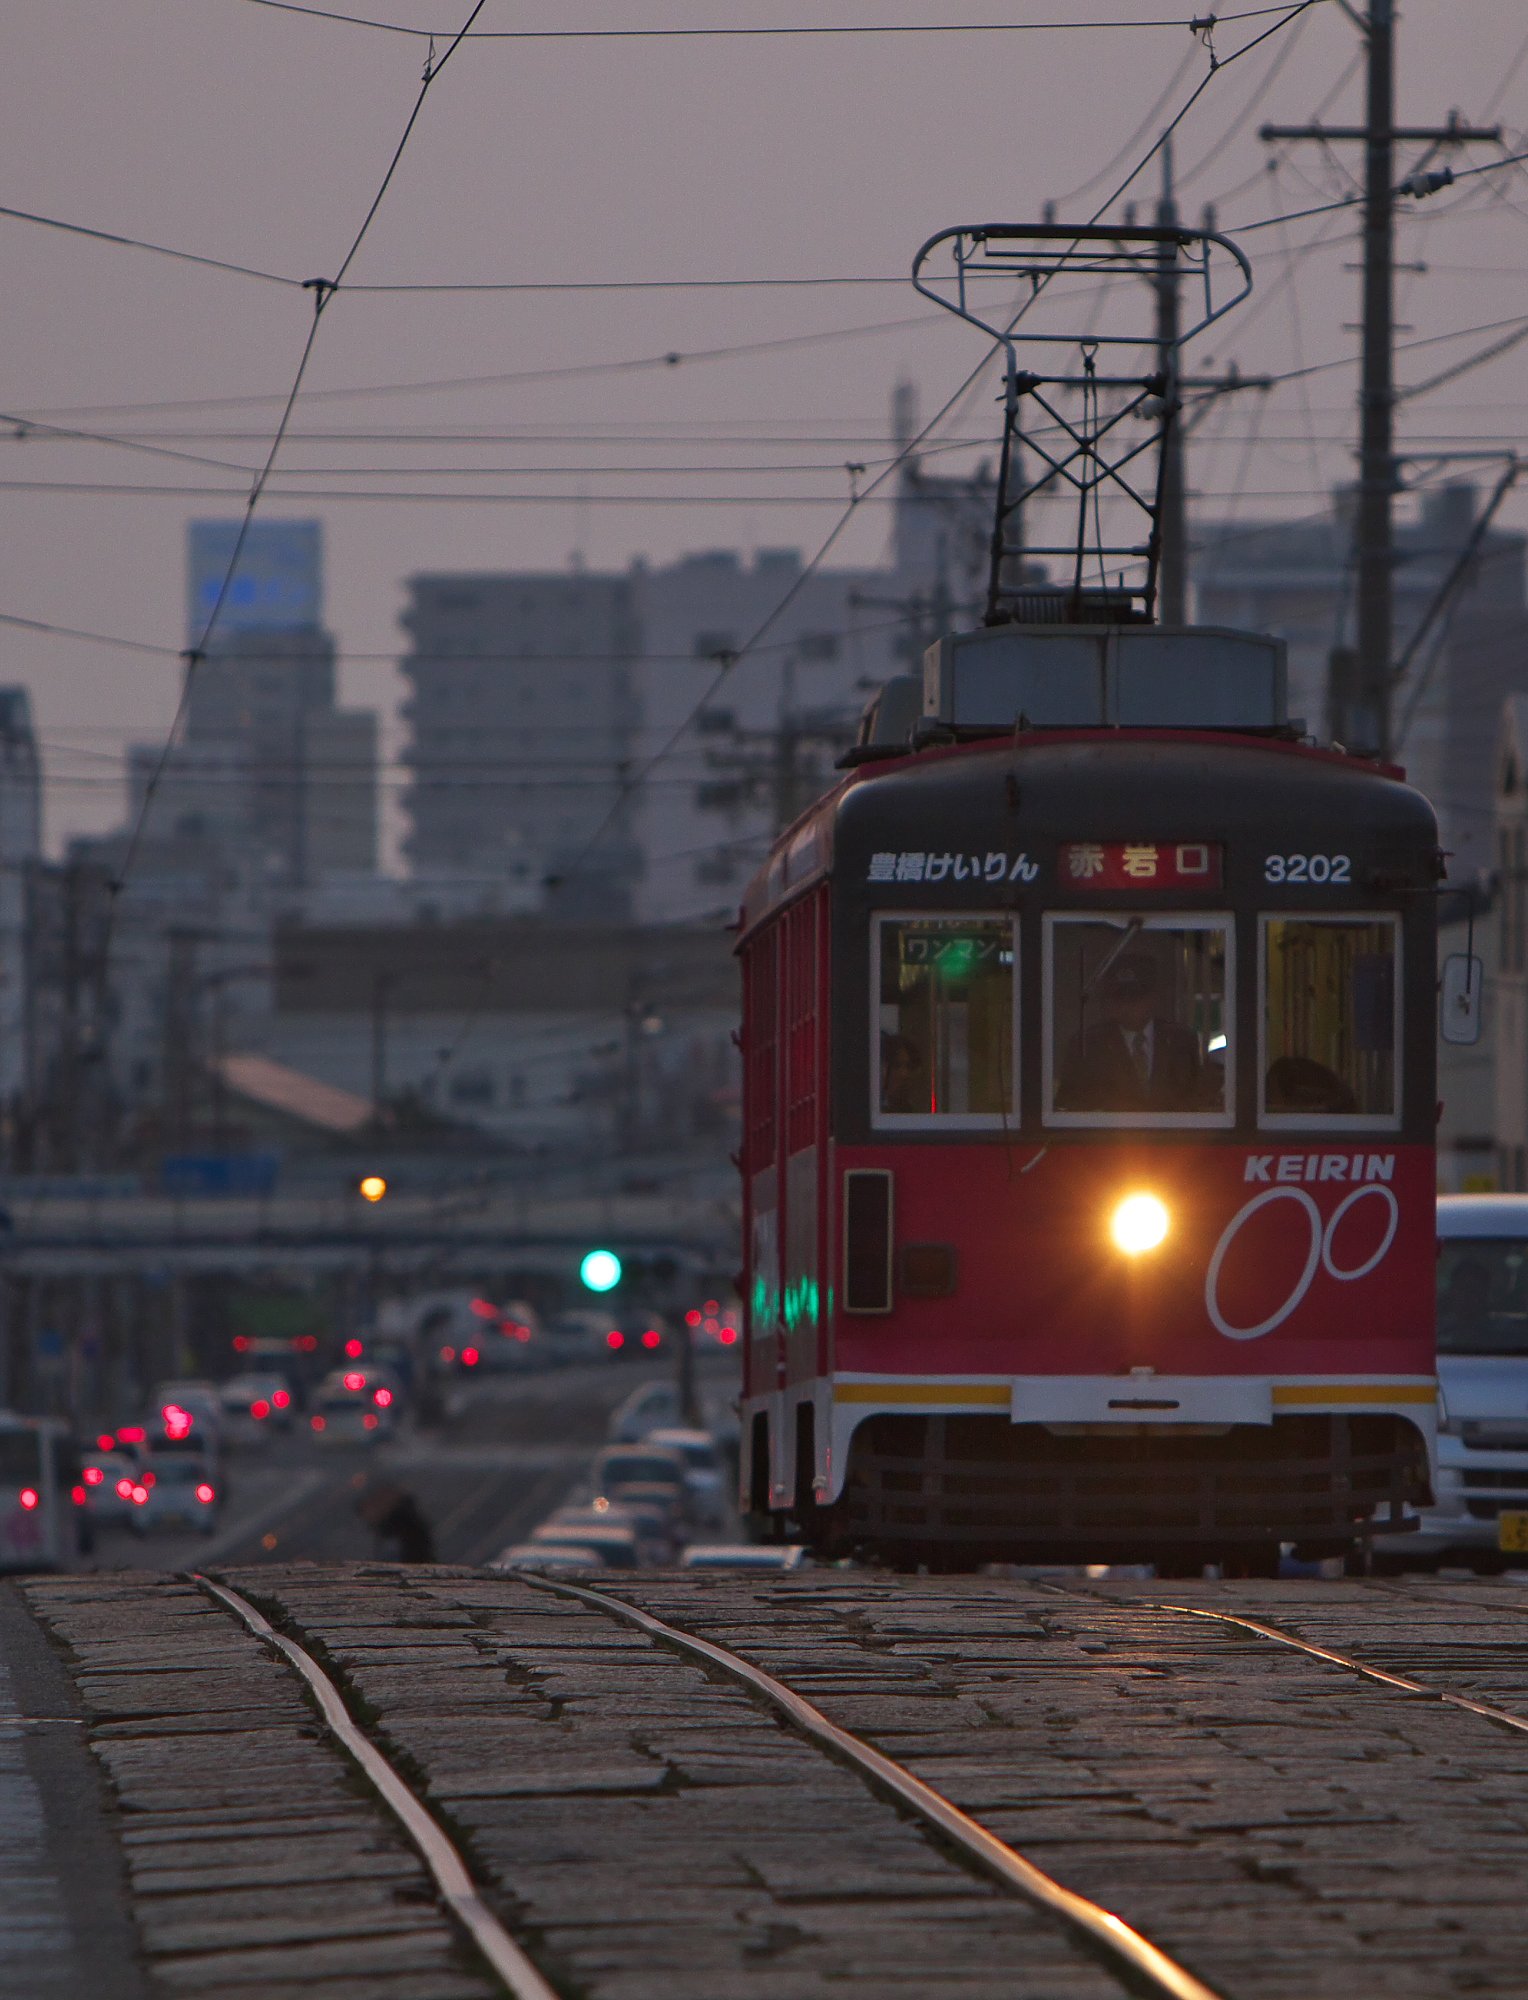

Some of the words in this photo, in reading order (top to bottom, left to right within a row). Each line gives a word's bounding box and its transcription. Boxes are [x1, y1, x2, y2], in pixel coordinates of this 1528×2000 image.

[866, 851, 1041, 882] 豊橋けいりん
[1068, 842, 1209, 878] 赤岩口
[1264, 853, 1351, 883] 3202
[907, 938, 999, 960] ワンマン
[1243, 1153, 1396, 1183] KEIRIN
